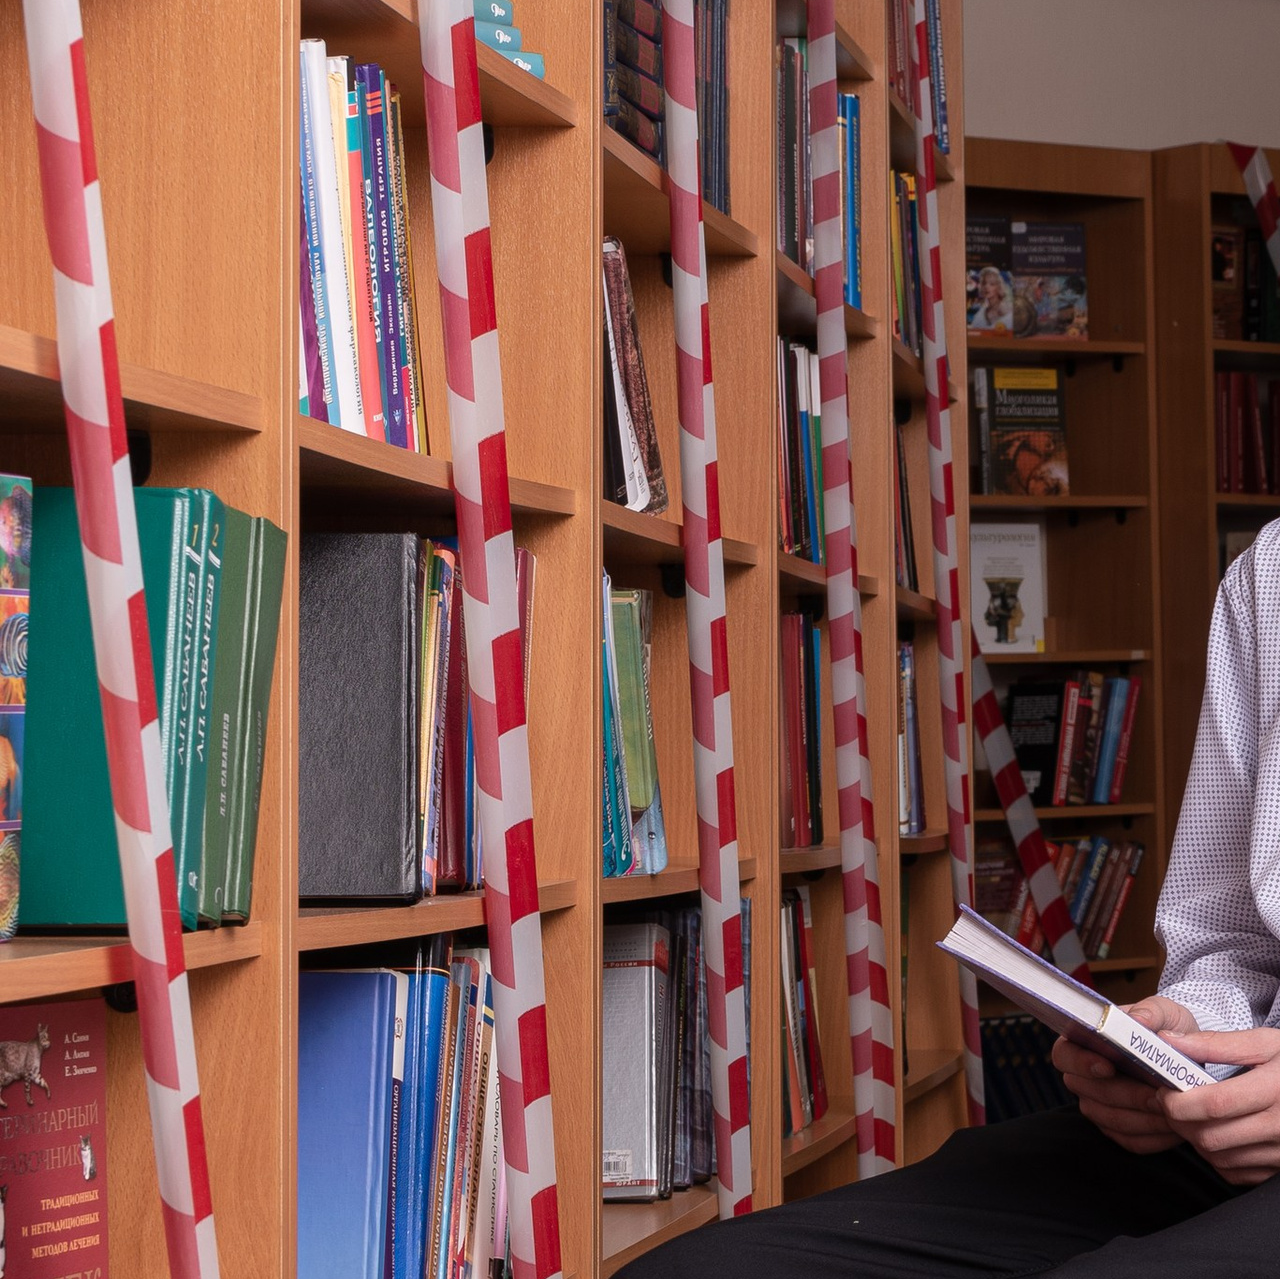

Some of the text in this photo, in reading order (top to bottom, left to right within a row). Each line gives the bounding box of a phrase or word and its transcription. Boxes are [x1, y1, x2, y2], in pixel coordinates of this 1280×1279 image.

[313, 251, 327, 320] АЛКОГОЛЬНОЙ
[364, 179, 383, 344] ВАЛЕОЛОГИЯ
[375, 137, 399, 396] Вирджиния Экслайн ИГРОВАЯ ТЕРАПИЯ
[396, 280, 405, 337] ГИГИЕНА
[318, 324, 334, 404] ЗАВИСИМОСТЬЮ
[191, 523, 199, 547] 1
[211, 522, 220, 548] 2
[179, 571, 197, 714] САБАНЕЕВ
[200, 572, 216, 714] САБАНЕЕВ
[220, 712, 231, 788] САБАНЕЕВ
[1129, 1030, 1209, 1090] НФОРМАТИКА
[390, 1084, 400, 1188] ОРГАНИЗАЦИОННАЯ
[431, 1026, 458, 1277] СОЦИАЛЬНОЕ ПРОЕКТИРОВАНИЕ
[468, 1051, 490, 1234] ОБЩЕСТВОЗНАНИЕ
[21, 1212, 101, 1238] И НЕТРАДИЦИОННЫХ
[40, 1189, 100, 1211] ТРАДИЦИОННЫХ
[488, 1165, 499, 1245] СТАТИСТИКЕ
[31, 1233, 101, 1260] МЕТОДОВ ЛЕЧЕНИЯ
